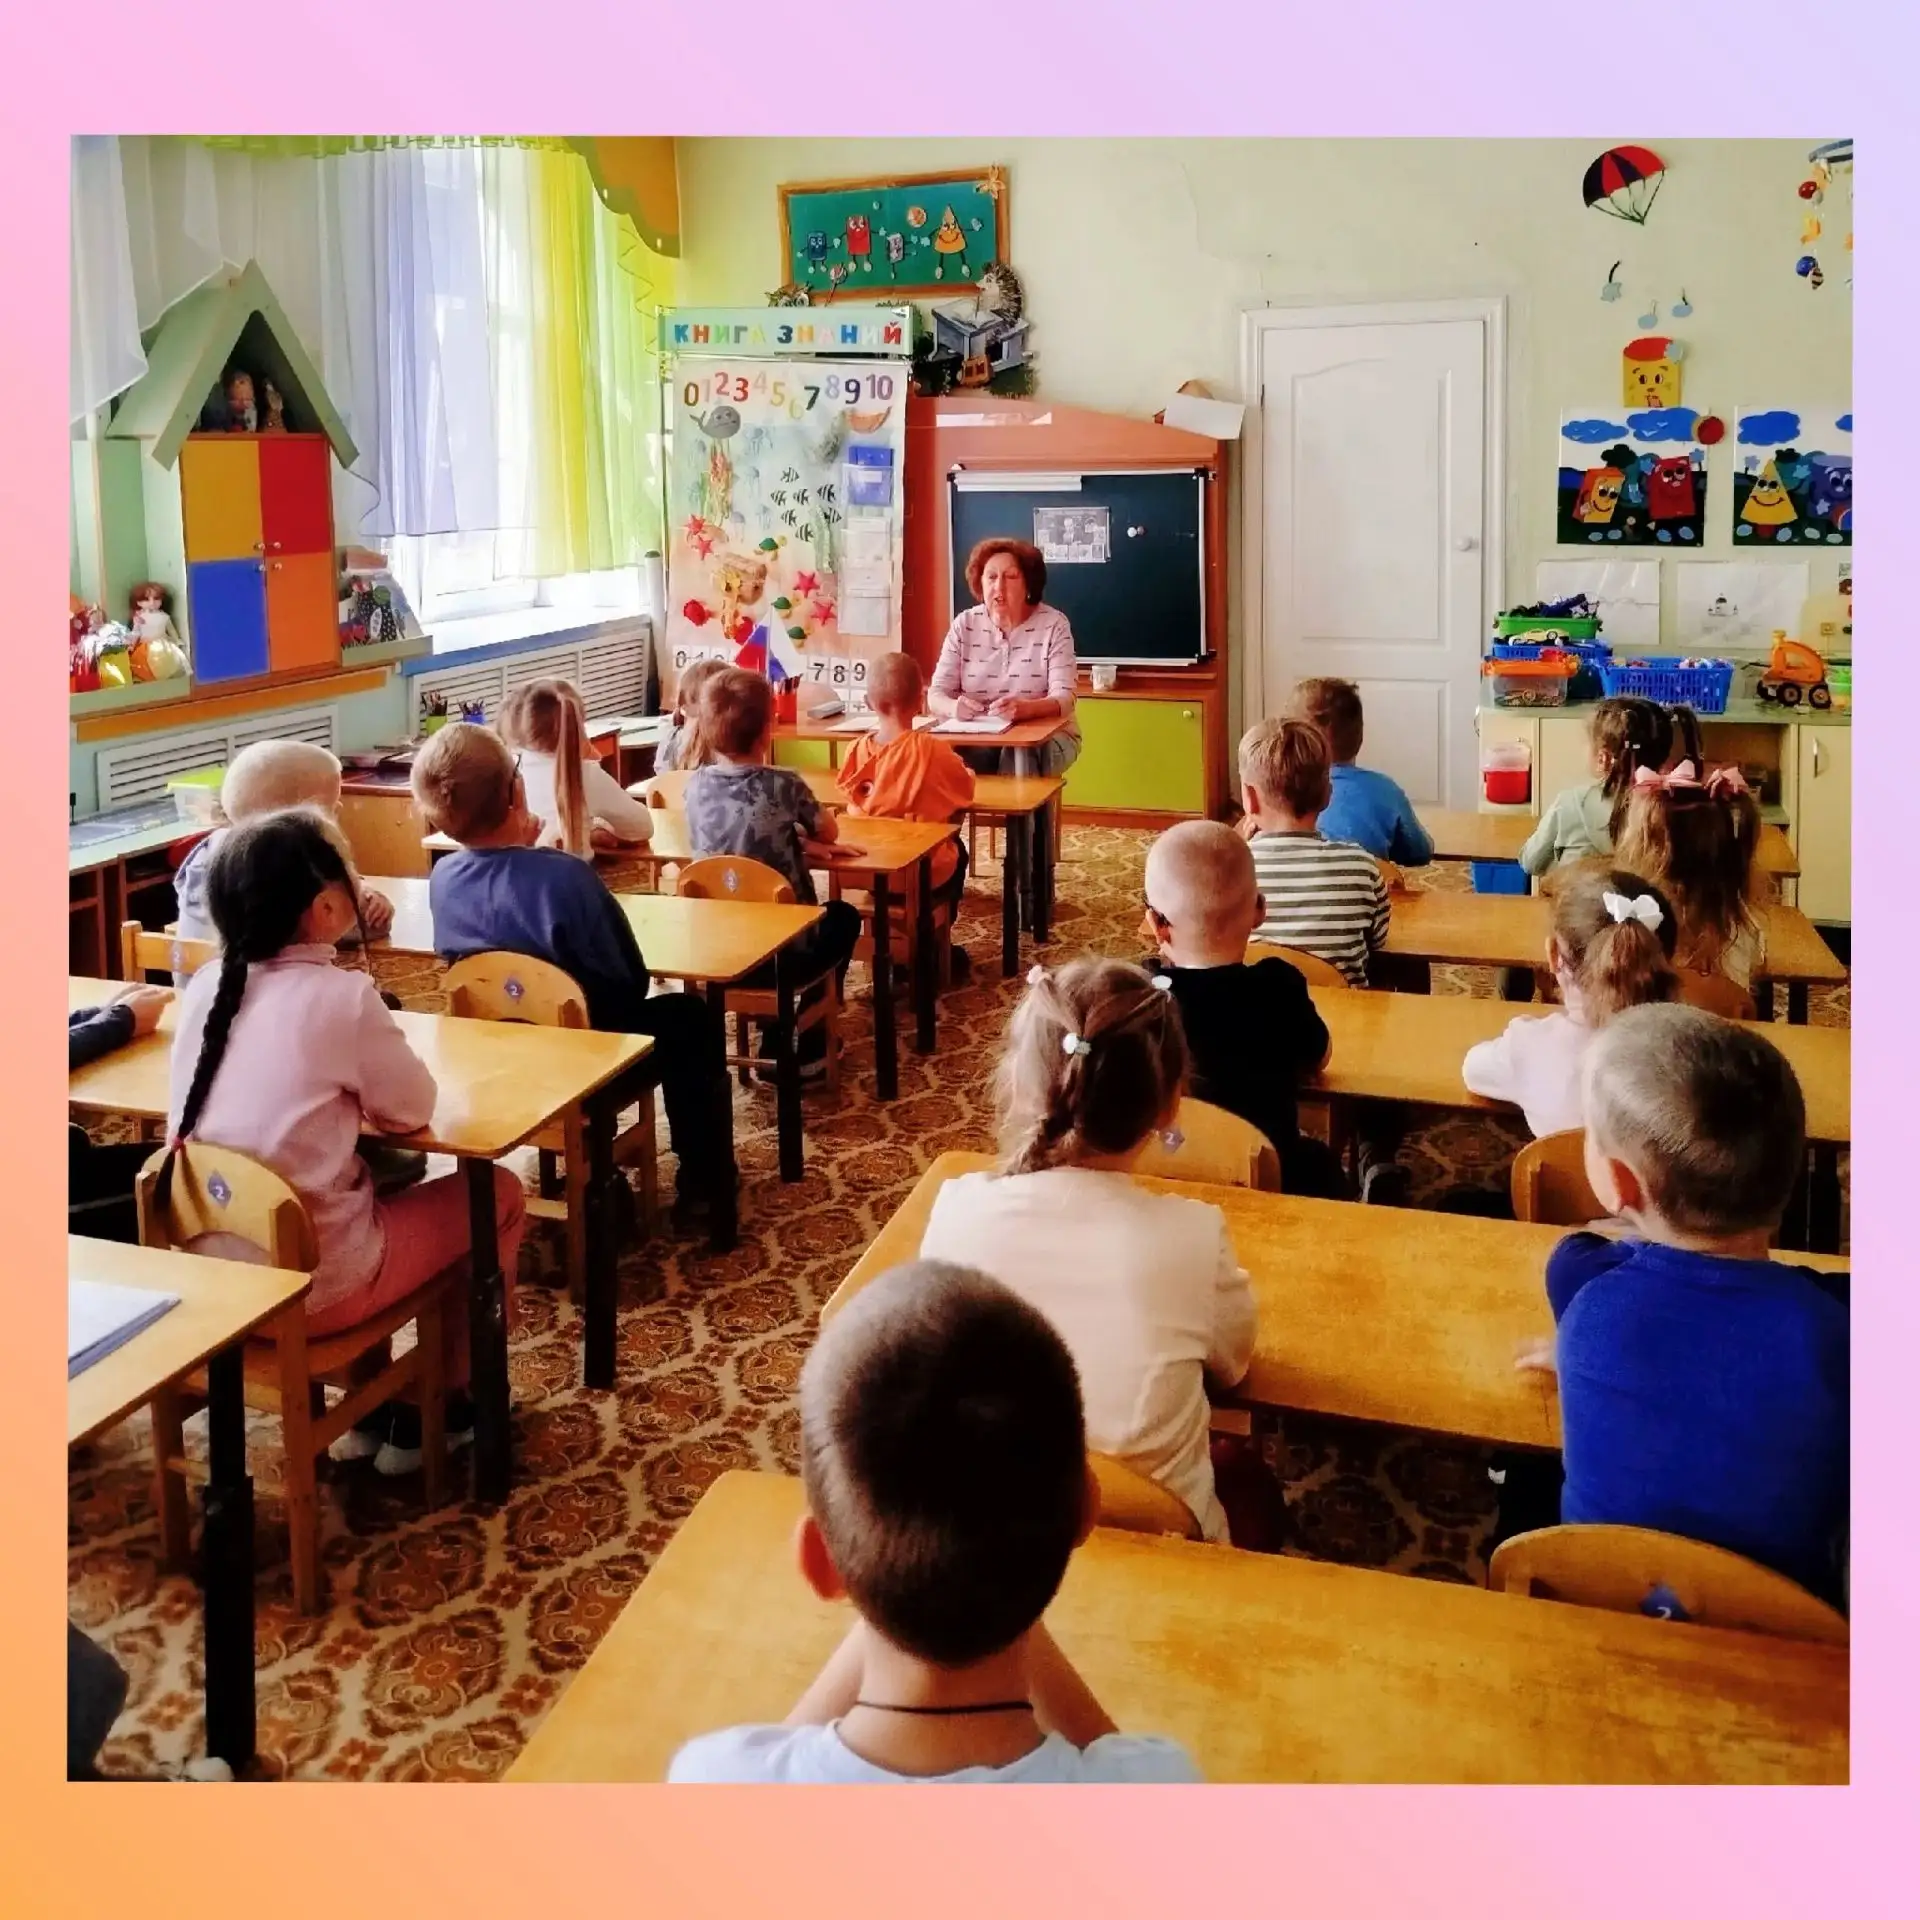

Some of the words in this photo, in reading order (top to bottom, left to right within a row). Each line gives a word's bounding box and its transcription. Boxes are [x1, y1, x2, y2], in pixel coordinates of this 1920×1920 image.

[674, 324, 766, 344] КНИГА
[777, 321, 902, 345] ЗНАНИЙ
[684, 382, 699, 407] 0
[701, 378, 711, 402] 1
[715, 372, 730, 396] 2
[733, 377, 749, 402] 3
[753, 371, 768, 394] 4
[770, 381, 786, 407] 5
[789, 398, 804, 420] 6
[804, 385, 821, 411] 7
[825, 374, 840, 399] 8
[845, 378, 860, 404] 9
[866, 373, 893, 400] 10
[813, 662, 824, 681] 7
[833, 665, 845, 683] 8
[854, 662, 865, 681] 9
[1165, 1132, 1175, 1145] 2
[215, 1185, 225, 1200] 2
